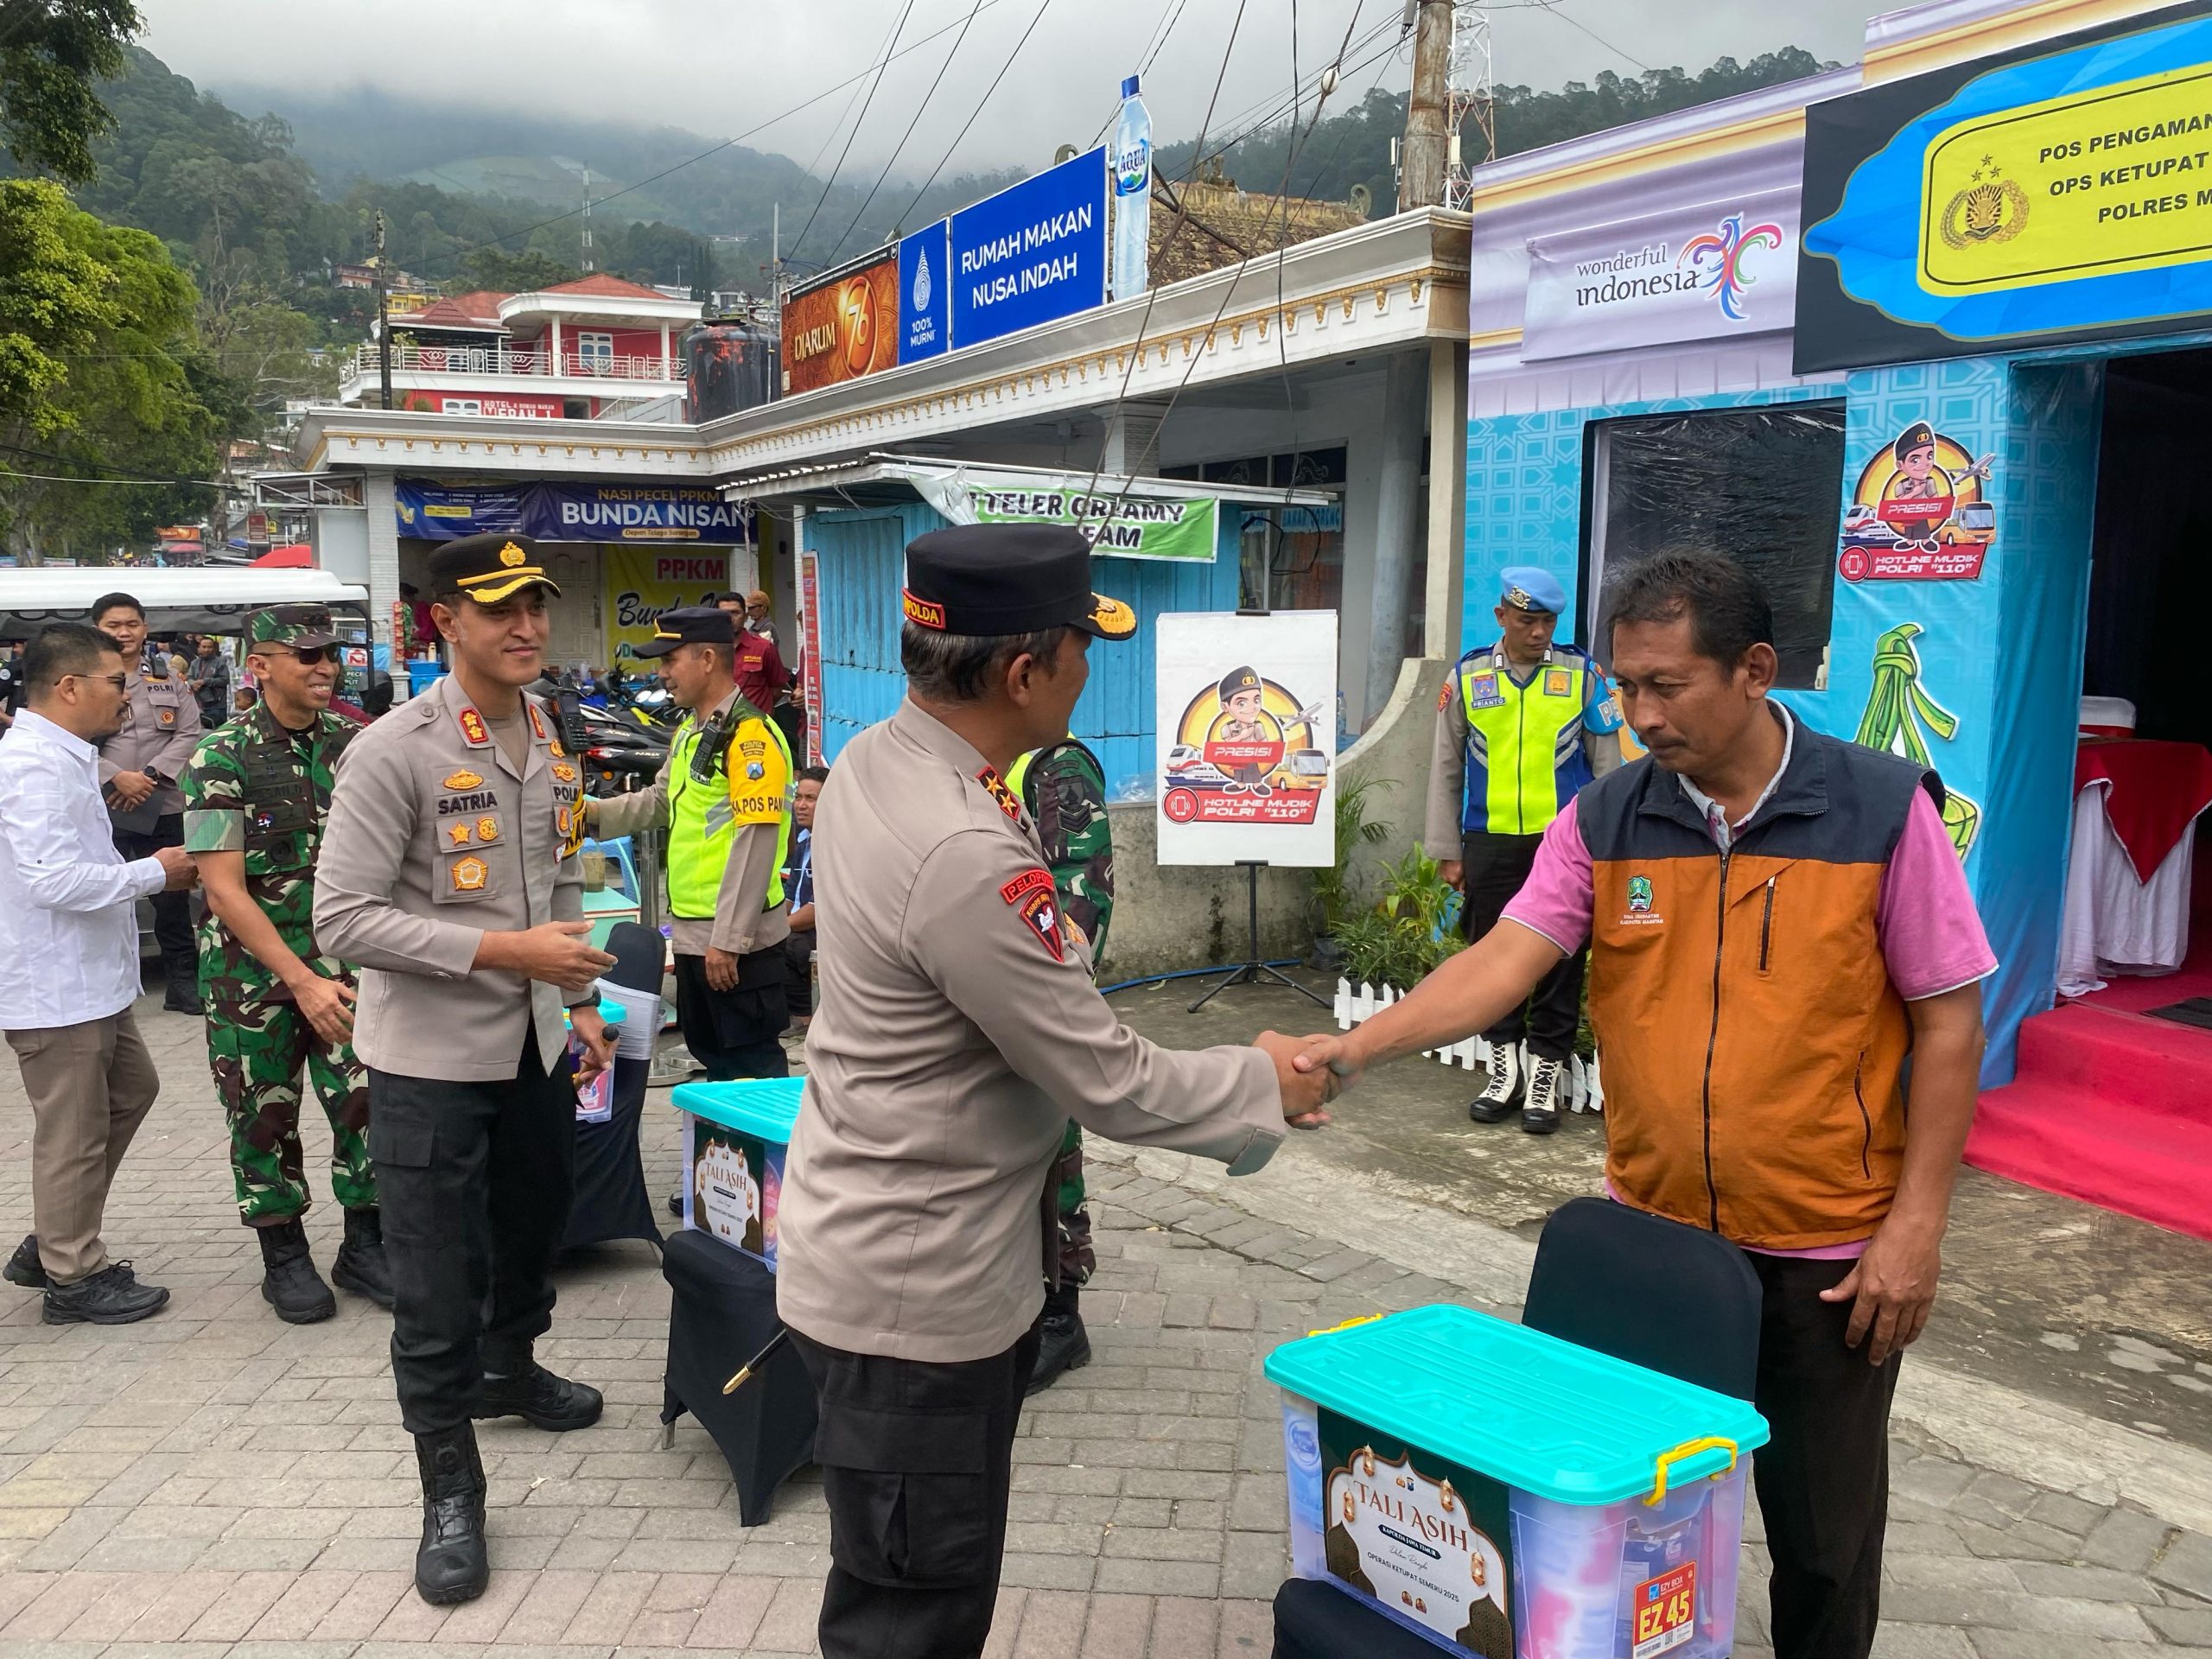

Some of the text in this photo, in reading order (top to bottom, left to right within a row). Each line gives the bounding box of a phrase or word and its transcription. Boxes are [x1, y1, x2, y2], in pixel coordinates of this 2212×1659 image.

[1120, 148, 1146, 173] AQUA
[2039, 141, 2082, 163] POS
[2050, 152, 2209, 196] OPS KETUPAT
[2098, 194, 2188, 223] POLRES
[962, 203, 1091, 275] RUMAH MAKAN
[1577, 245, 1667, 276] wonderful
[973, 252, 1077, 309] NUSA INDAH
[1576, 270, 1701, 306] indonesia
[912, 316, 933, 333] 100%
[794, 321, 836, 361] DJARUM
[911, 331, 935, 347] MURNI
[484, 400, 510, 409] HOTEL
[598, 489, 720, 502] NASI PECEL PPKM
[985, 493, 1062, 517] TELER
[562, 502, 749, 527] BUNDA NISAN
[1887, 503, 1943, 514] PRESISI
[657, 559, 724, 580] PPKM
[1874, 564, 1923, 574] POLRI
[1472, 697, 1504, 708] PRIANTO
[1214, 747, 1272, 756] PRESISI
[438, 791, 498, 815] SATRIA
[743, 797, 765, 813] POS
[1204, 798, 1313, 808] HOTLINE MUDIK
[1204, 807, 1255, 816] POLRI
[705, 1162, 747, 1191] TALI ASIH
[1354, 1481, 1468, 1552] TALI ASIH
[1420, 1542, 1437, 1556] TIMUR
[1367, 1552, 1459, 1602] OPERASI KETUPAT SEMERU 2025
[1661, 1581, 1671, 1592] EZY
[1671, 1575, 1683, 1587] BOX
[1639, 1601, 1664, 1642] EZ
[1666, 1589, 1690, 1627] 45
